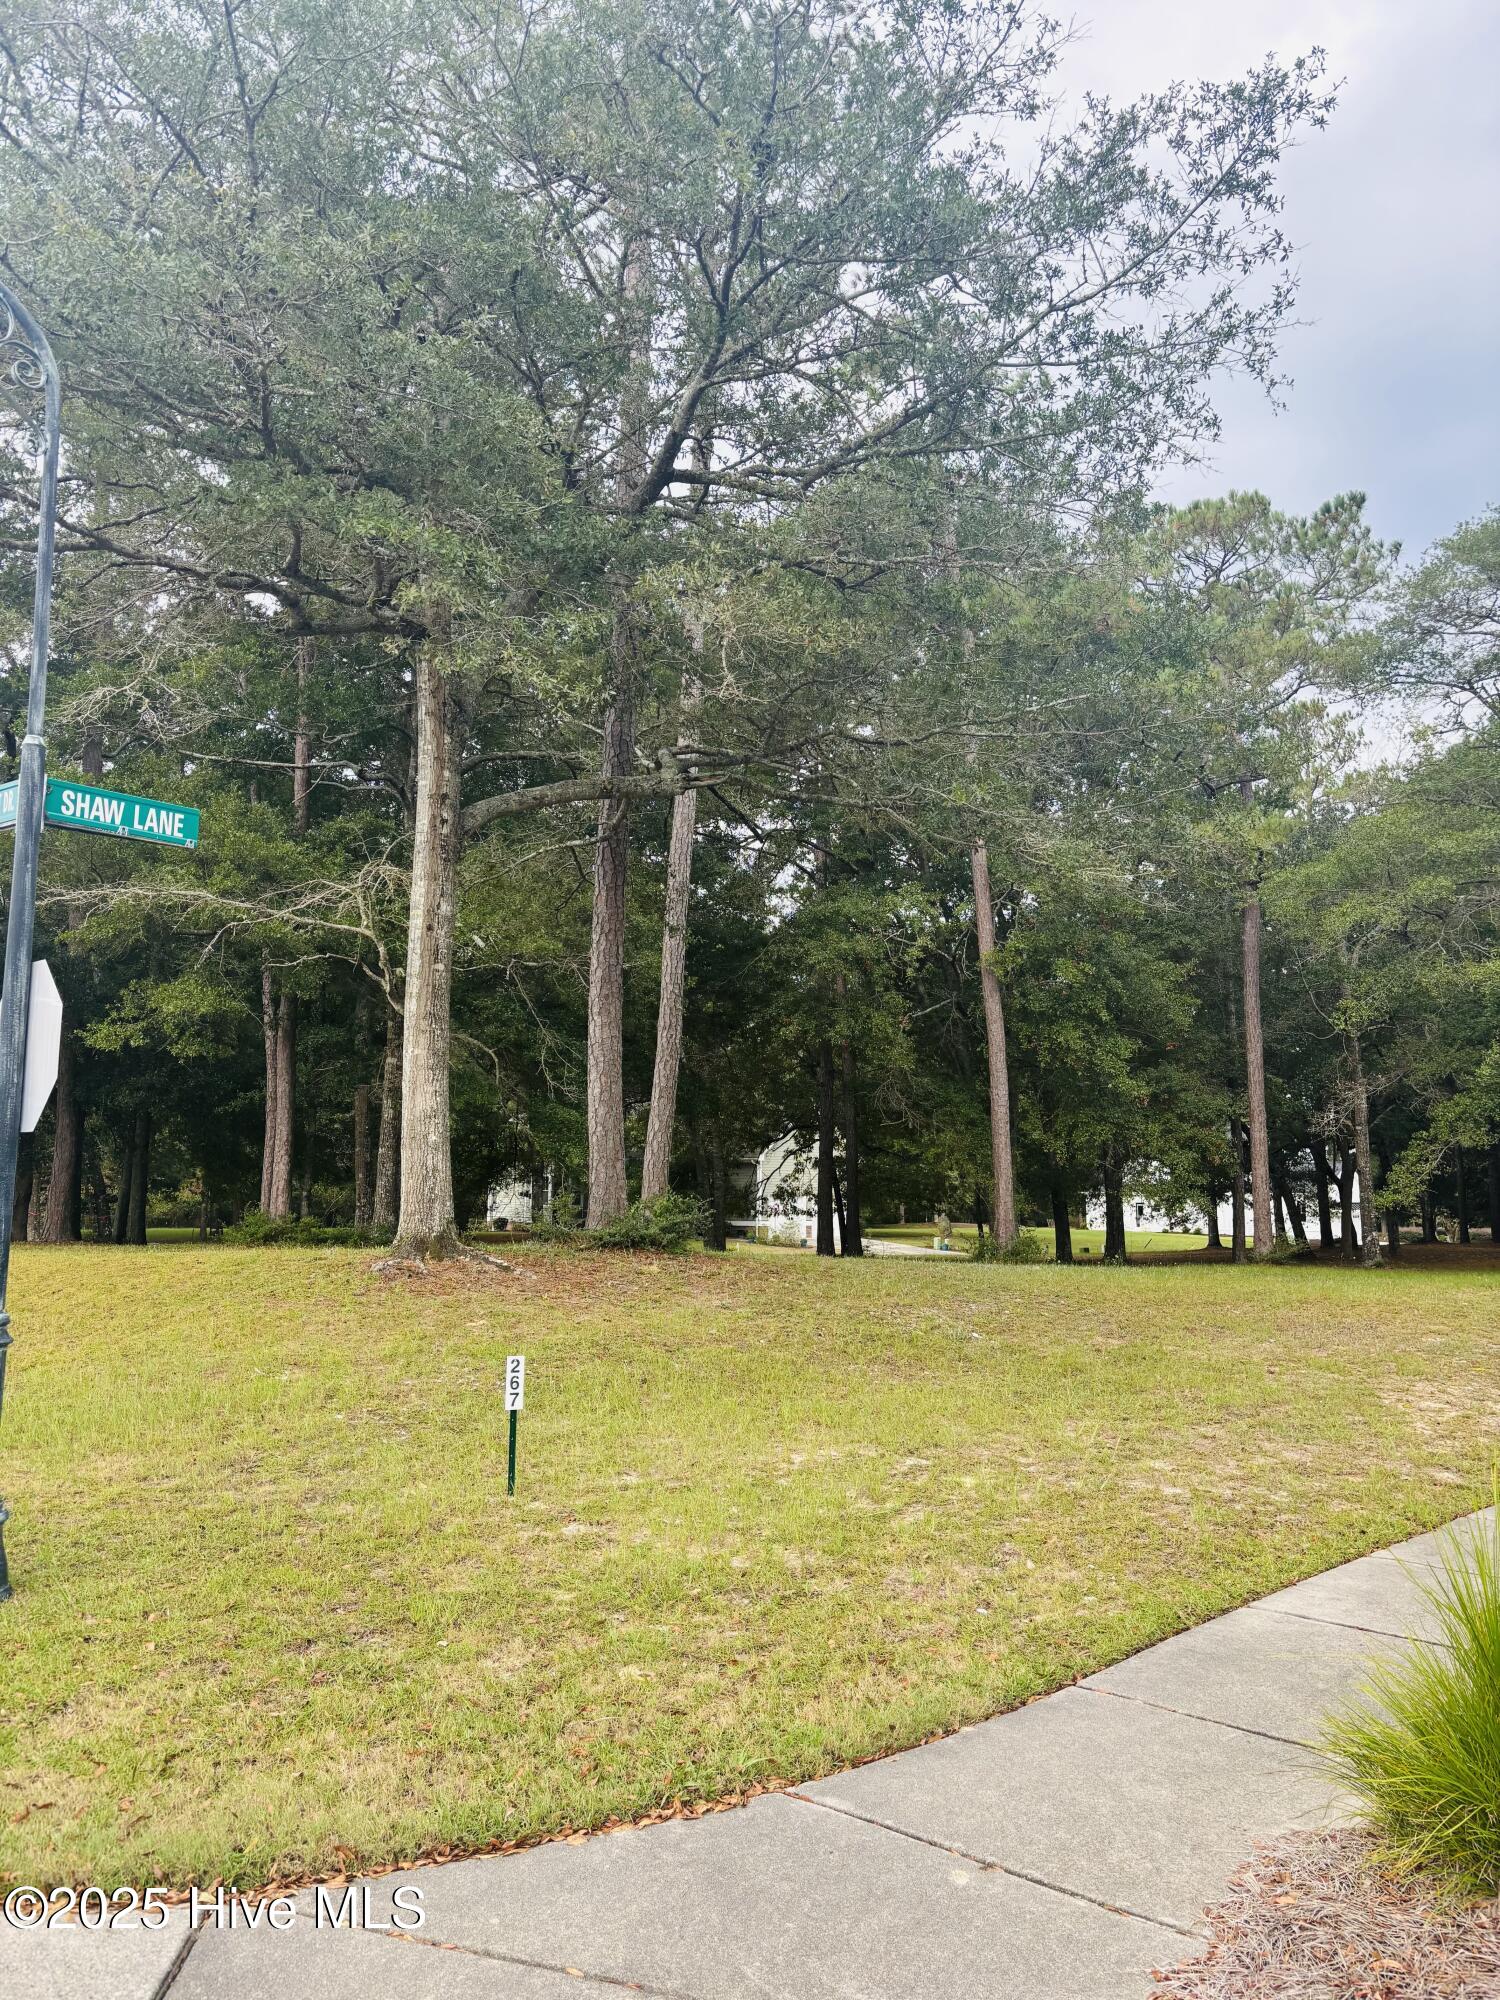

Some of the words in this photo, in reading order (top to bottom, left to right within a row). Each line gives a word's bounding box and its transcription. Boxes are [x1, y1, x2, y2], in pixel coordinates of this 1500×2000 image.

[61, 790, 125, 825] SHAW
[133, 804, 185, 838] LANE
[509, 1358, 521, 1407] 267
